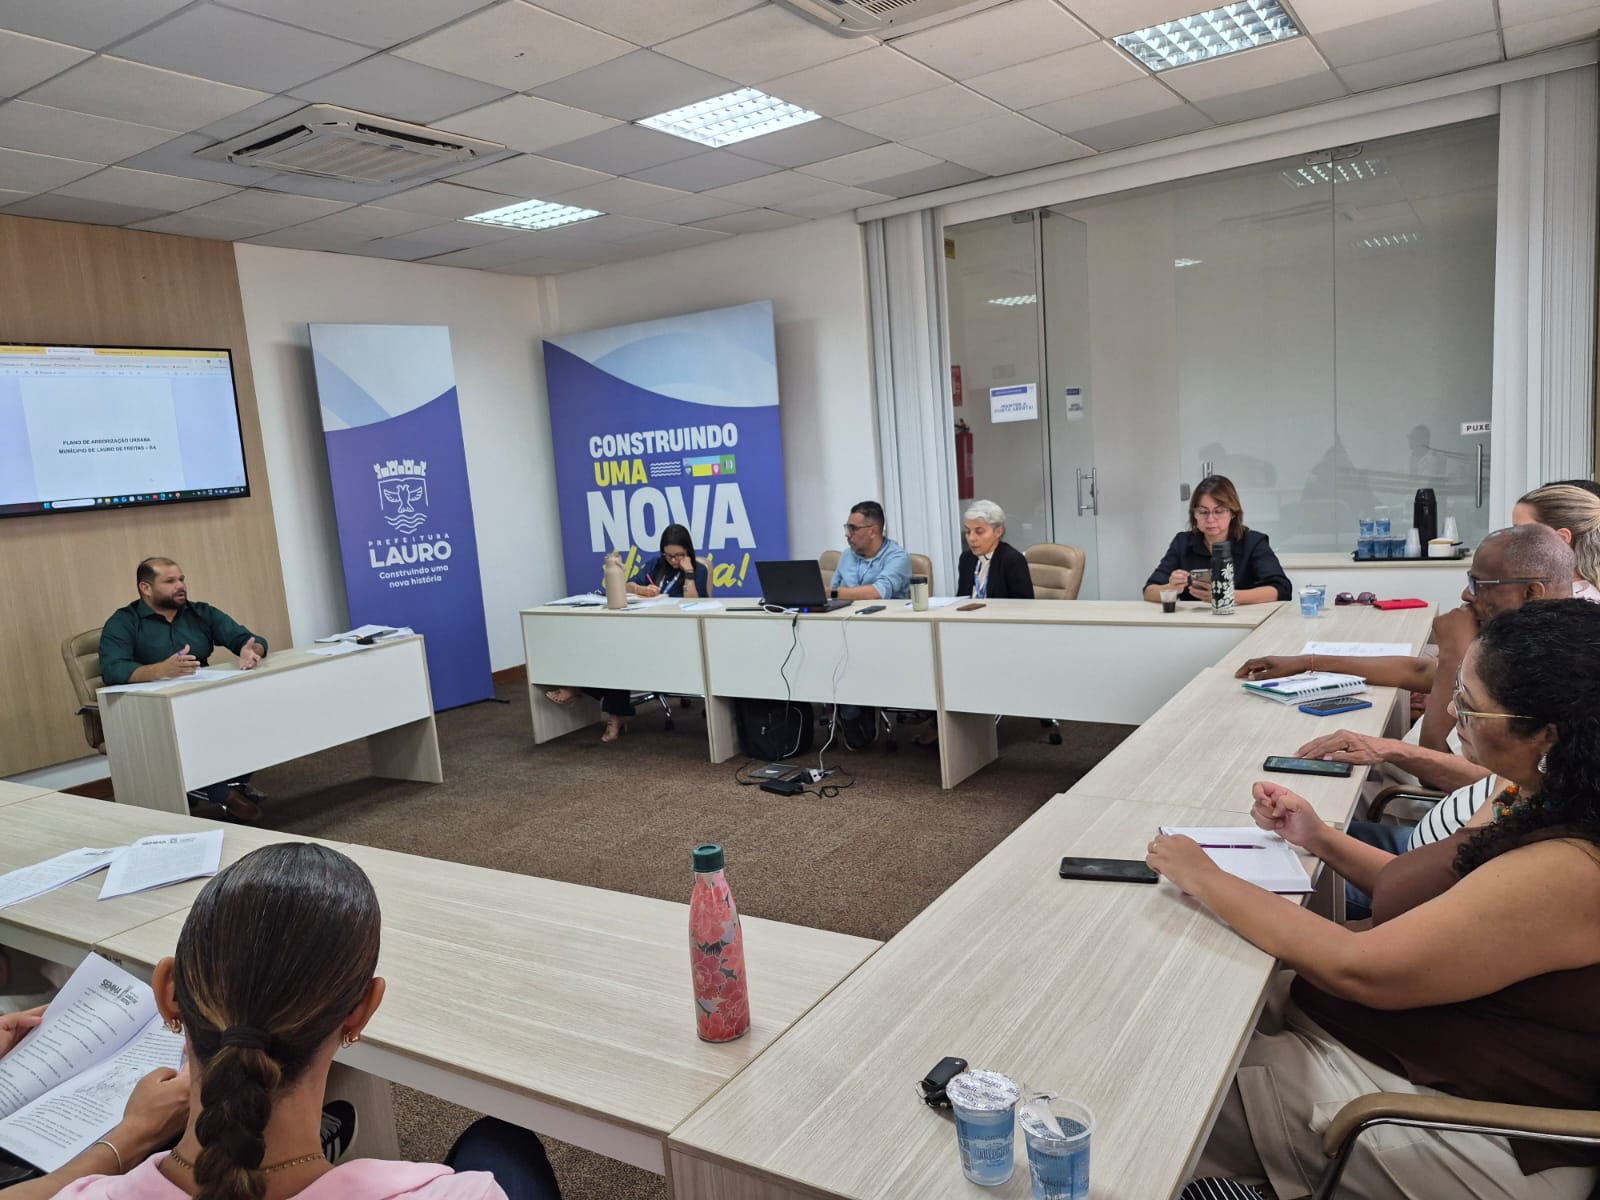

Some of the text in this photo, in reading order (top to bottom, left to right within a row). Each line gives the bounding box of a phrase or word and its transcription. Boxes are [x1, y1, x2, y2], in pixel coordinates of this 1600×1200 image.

[1466, 424, 1490, 432] PUXE
[589, 422, 738, 459] CONSTRUINDO
[593, 458, 648, 487] UMA
[586, 482, 757, 553] NOVA
[368, 533, 450, 547] PREFEITURA
[369, 540, 452, 568] LAURO
[379, 565, 449, 580] Construindo uma
[389, 574, 442, 588] nova história
